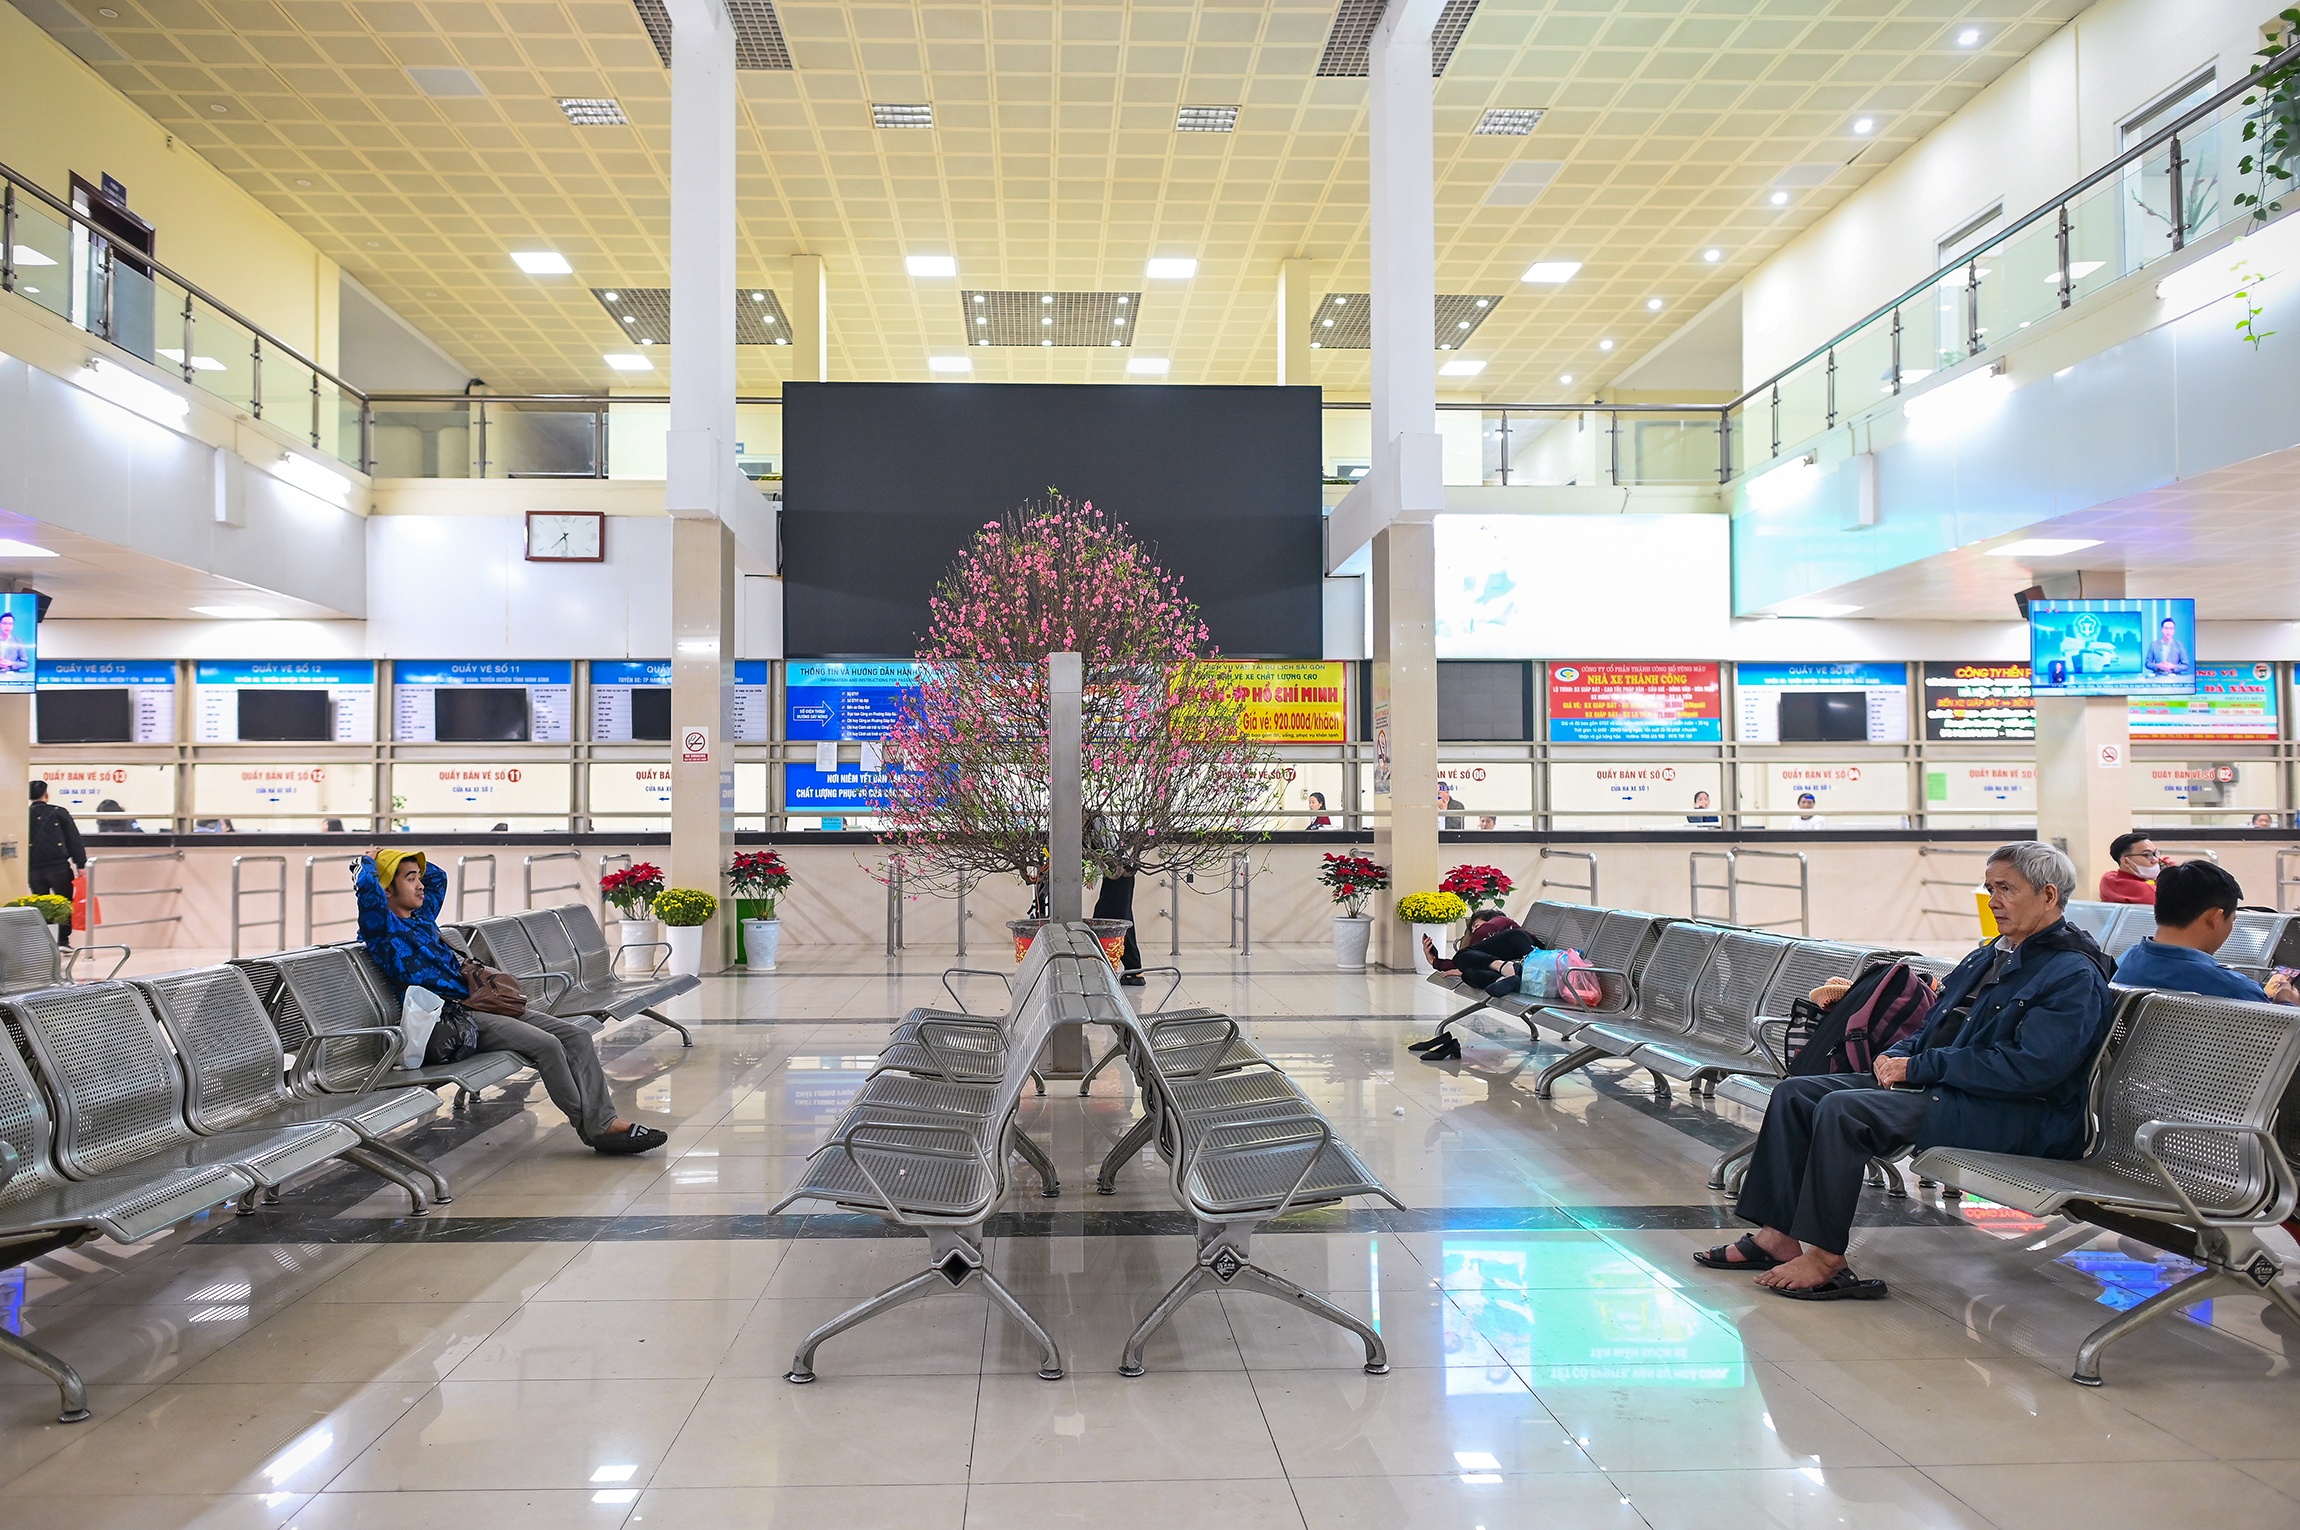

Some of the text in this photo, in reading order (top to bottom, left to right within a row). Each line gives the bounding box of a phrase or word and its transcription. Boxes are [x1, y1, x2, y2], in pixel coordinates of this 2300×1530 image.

[85, 664, 97, 673] VÉ
[100, 663, 113, 673] SỐ
[281, 664, 293, 673] VÉ
[296, 663, 309, 673] SỐ
[480, 664, 492, 673] VÉ
[495, 663, 508, 673] SỐ
[800, 667, 826, 675] THÔNG
[852, 667, 878, 675] HƯỚNG
[880, 666, 895, 675] DẪN
[1816, 666, 1827, 674] VÉ
[1830, 665, 1843, 674] SỐ
[1956, 666, 1989, 678] CÔNG
[1989, 668, 2002, 678] TY
[1257, 672, 1275, 680] CHẤT
[1278, 673, 1301, 682] LƯỢNG
[1588, 672, 1688, 685] NHÀ XE THÀNH CÔNG
[1252, 682, 1338, 703] HỒ CHÍ MINH
[1243, 711, 1258, 730] Giá
[1260, 711, 1271, 730] vé:
[1274, 711, 1339, 730] 920.000đ/khách
[68, 770, 85, 781] BÁN
[86, 770, 97, 781] VÉ
[100, 770, 111, 781] SỐ
[114, 770, 124, 782] 13
[266, 769, 283, 781] BÁN
[285, 769, 295, 781] VÉ
[298, 769, 308, 781] SỐ
[313, 770, 325, 782] 12
[463, 770, 480, 781] BÁN
[482, 769, 492, 781] VÉ
[495, 769, 506, 781] SỐ
[511, 770, 519, 782] 11
[827, 772, 872, 783] NƠI NIÊM YẾT
[1259, 770, 1268, 780] VÉ
[1271, 770, 1281, 780] SỐ
[1448, 768, 1485, 780] VÉ SỐ 06
[1620, 769, 1636, 779] BÁN
[1639, 769, 1647, 779] VÉ
[1650, 768, 1660, 779] SỐ
[1806, 769, 1821, 779] BÁN
[1823, 769, 1833, 779] VÉ
[1836, 768, 1846, 779] SỐ
[1992, 769, 2008, 779] BÁN
[2010, 769, 2019, 779] VÉ
[2022, 770, 2032, 779] SỐ
[2175, 769, 2190, 780] BÁN
[2192, 769, 2201, 780] VÉ
[2204, 768, 2215, 780] SỐ
[2220, 769, 2231, 780] 02
[796, 786, 856, 799] CHẤT LƯỢNG PHỤC
